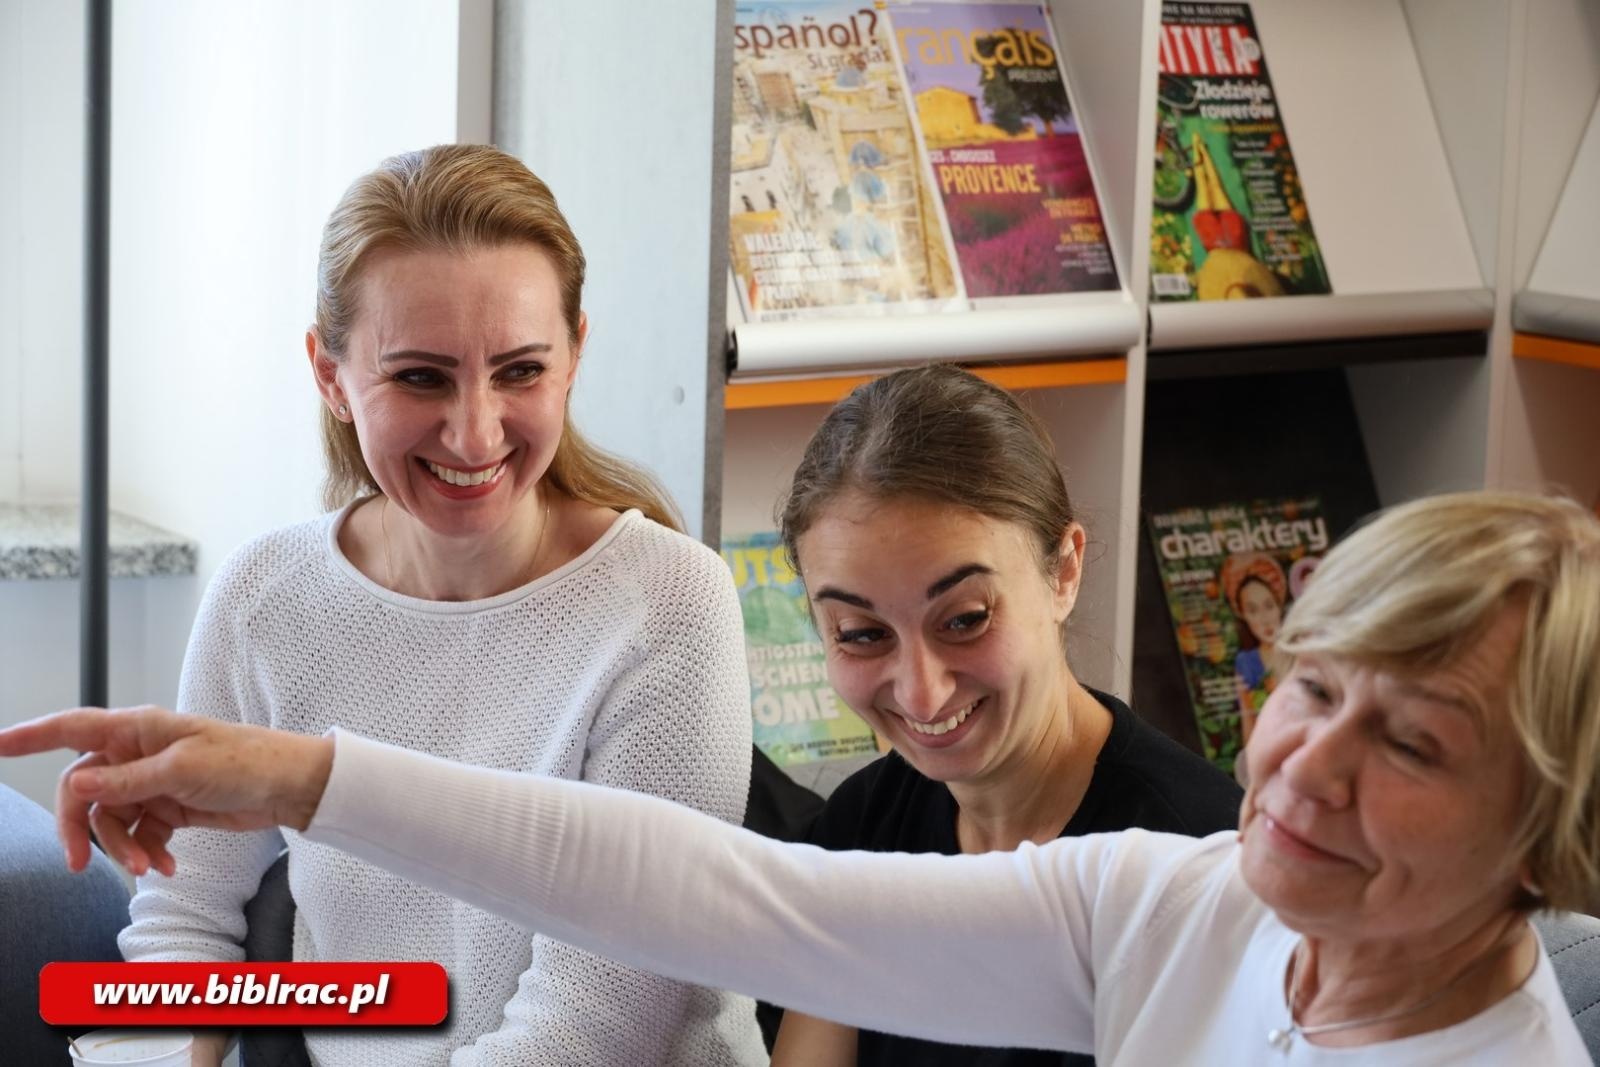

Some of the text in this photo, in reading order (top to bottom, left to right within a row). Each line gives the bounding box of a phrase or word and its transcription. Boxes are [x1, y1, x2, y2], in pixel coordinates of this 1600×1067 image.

[1192, 79, 1270, 106] Złodzieje
[1200, 102, 1275, 120] rowerów
[938, 163, 1042, 194] PROVENCE
[1161, 517, 1329, 560] charaktery
